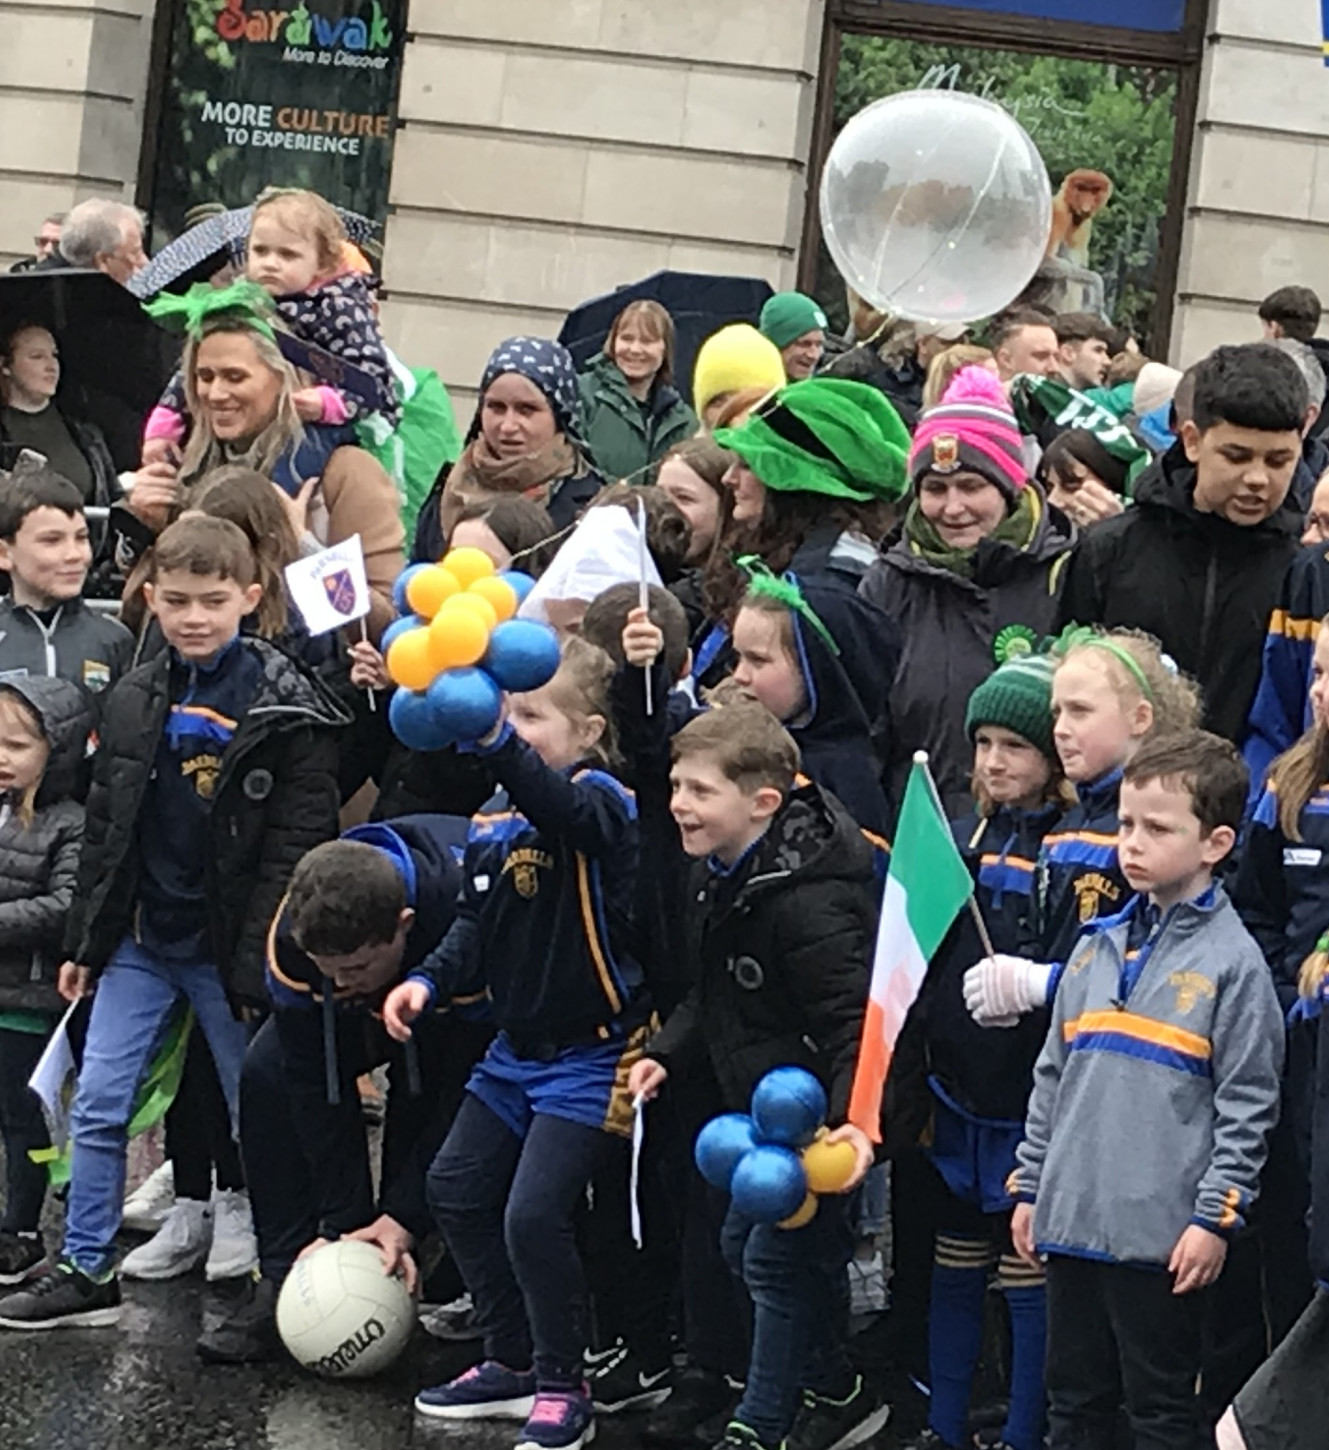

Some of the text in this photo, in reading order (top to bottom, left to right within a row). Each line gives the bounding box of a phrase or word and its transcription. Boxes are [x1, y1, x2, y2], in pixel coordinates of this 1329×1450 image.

[281, 46, 389, 70] More to Discover
[201, 101, 391, 138] MORE CULTURE
[225, 126, 360, 156] TO EXPERIENCE
